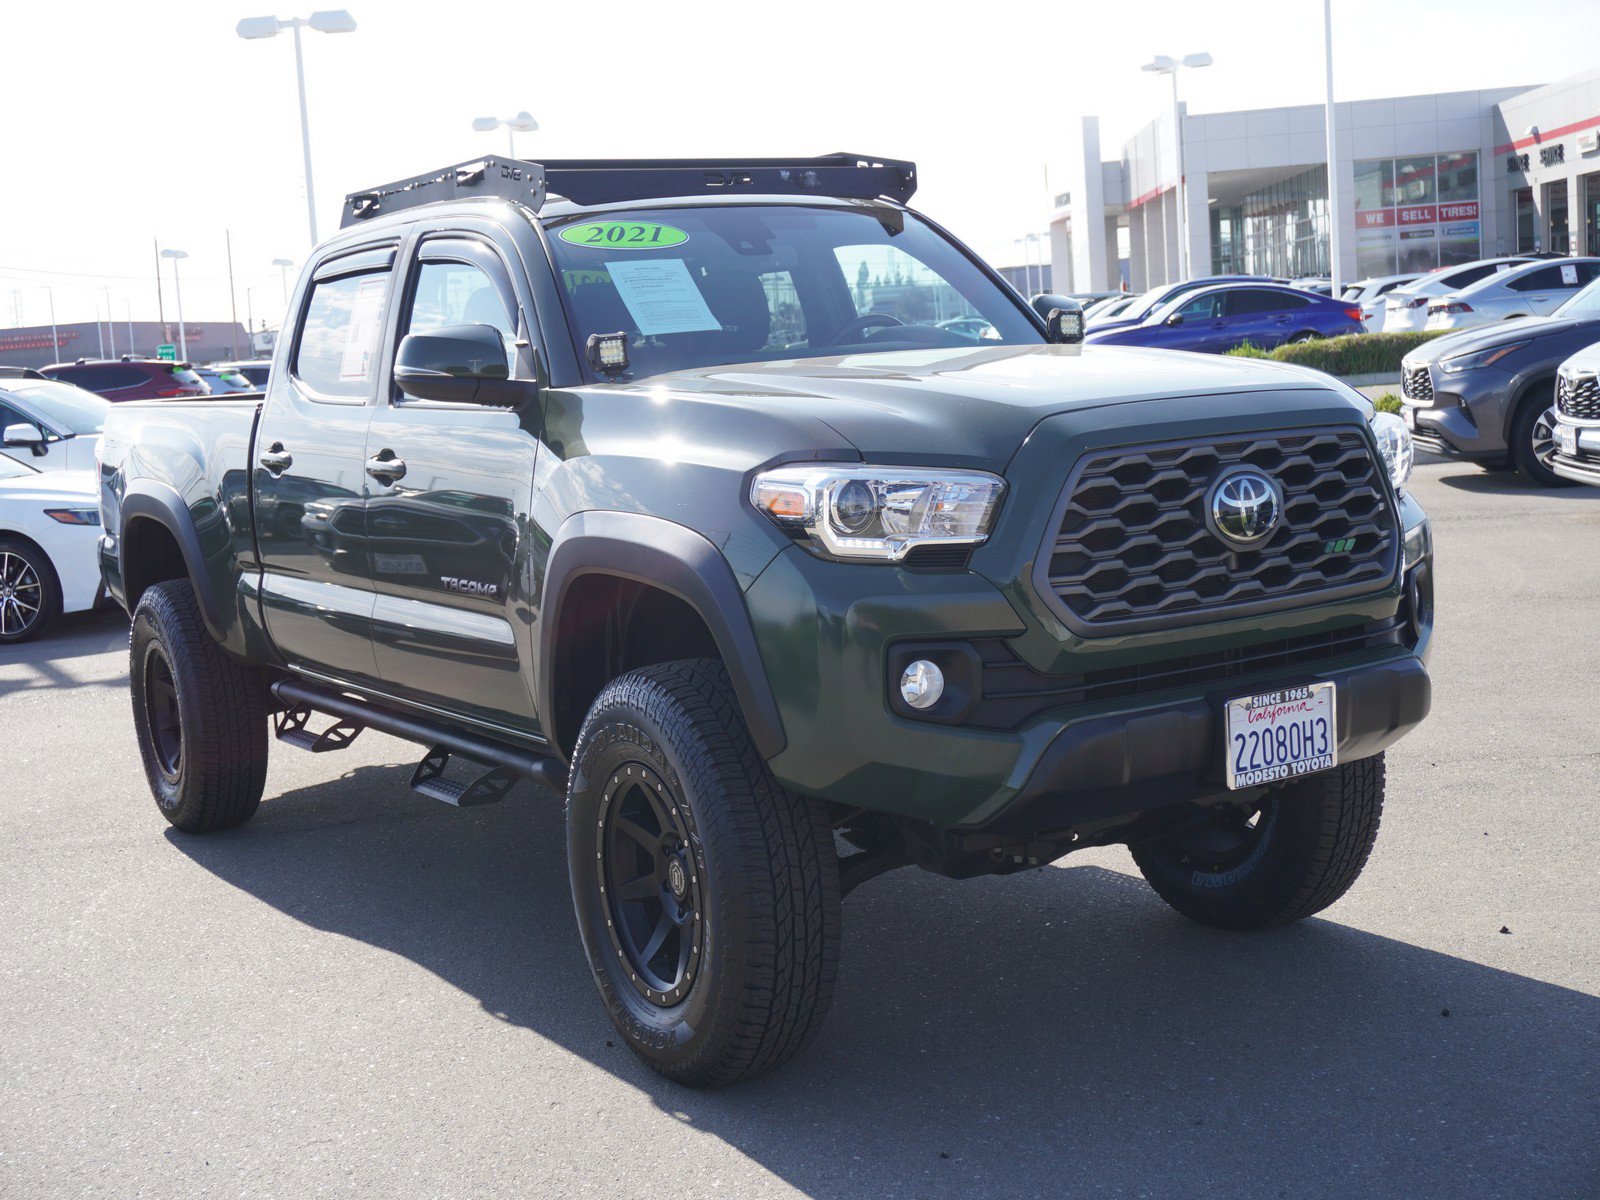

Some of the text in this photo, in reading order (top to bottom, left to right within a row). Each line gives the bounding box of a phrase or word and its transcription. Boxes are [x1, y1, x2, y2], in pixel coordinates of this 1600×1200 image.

[1365, 205, 1477, 224] WE SELL TIRES!
[585, 225, 664, 243] 2021
[441, 576, 498, 597] TACOMA
[1253, 687, 1308, 708] SINCE 1965
[1248, 701, 1314, 725] California
[1234, 717, 1328, 773] 22080H3
[1235, 755, 1333, 788] MODESTO TOYOTA
